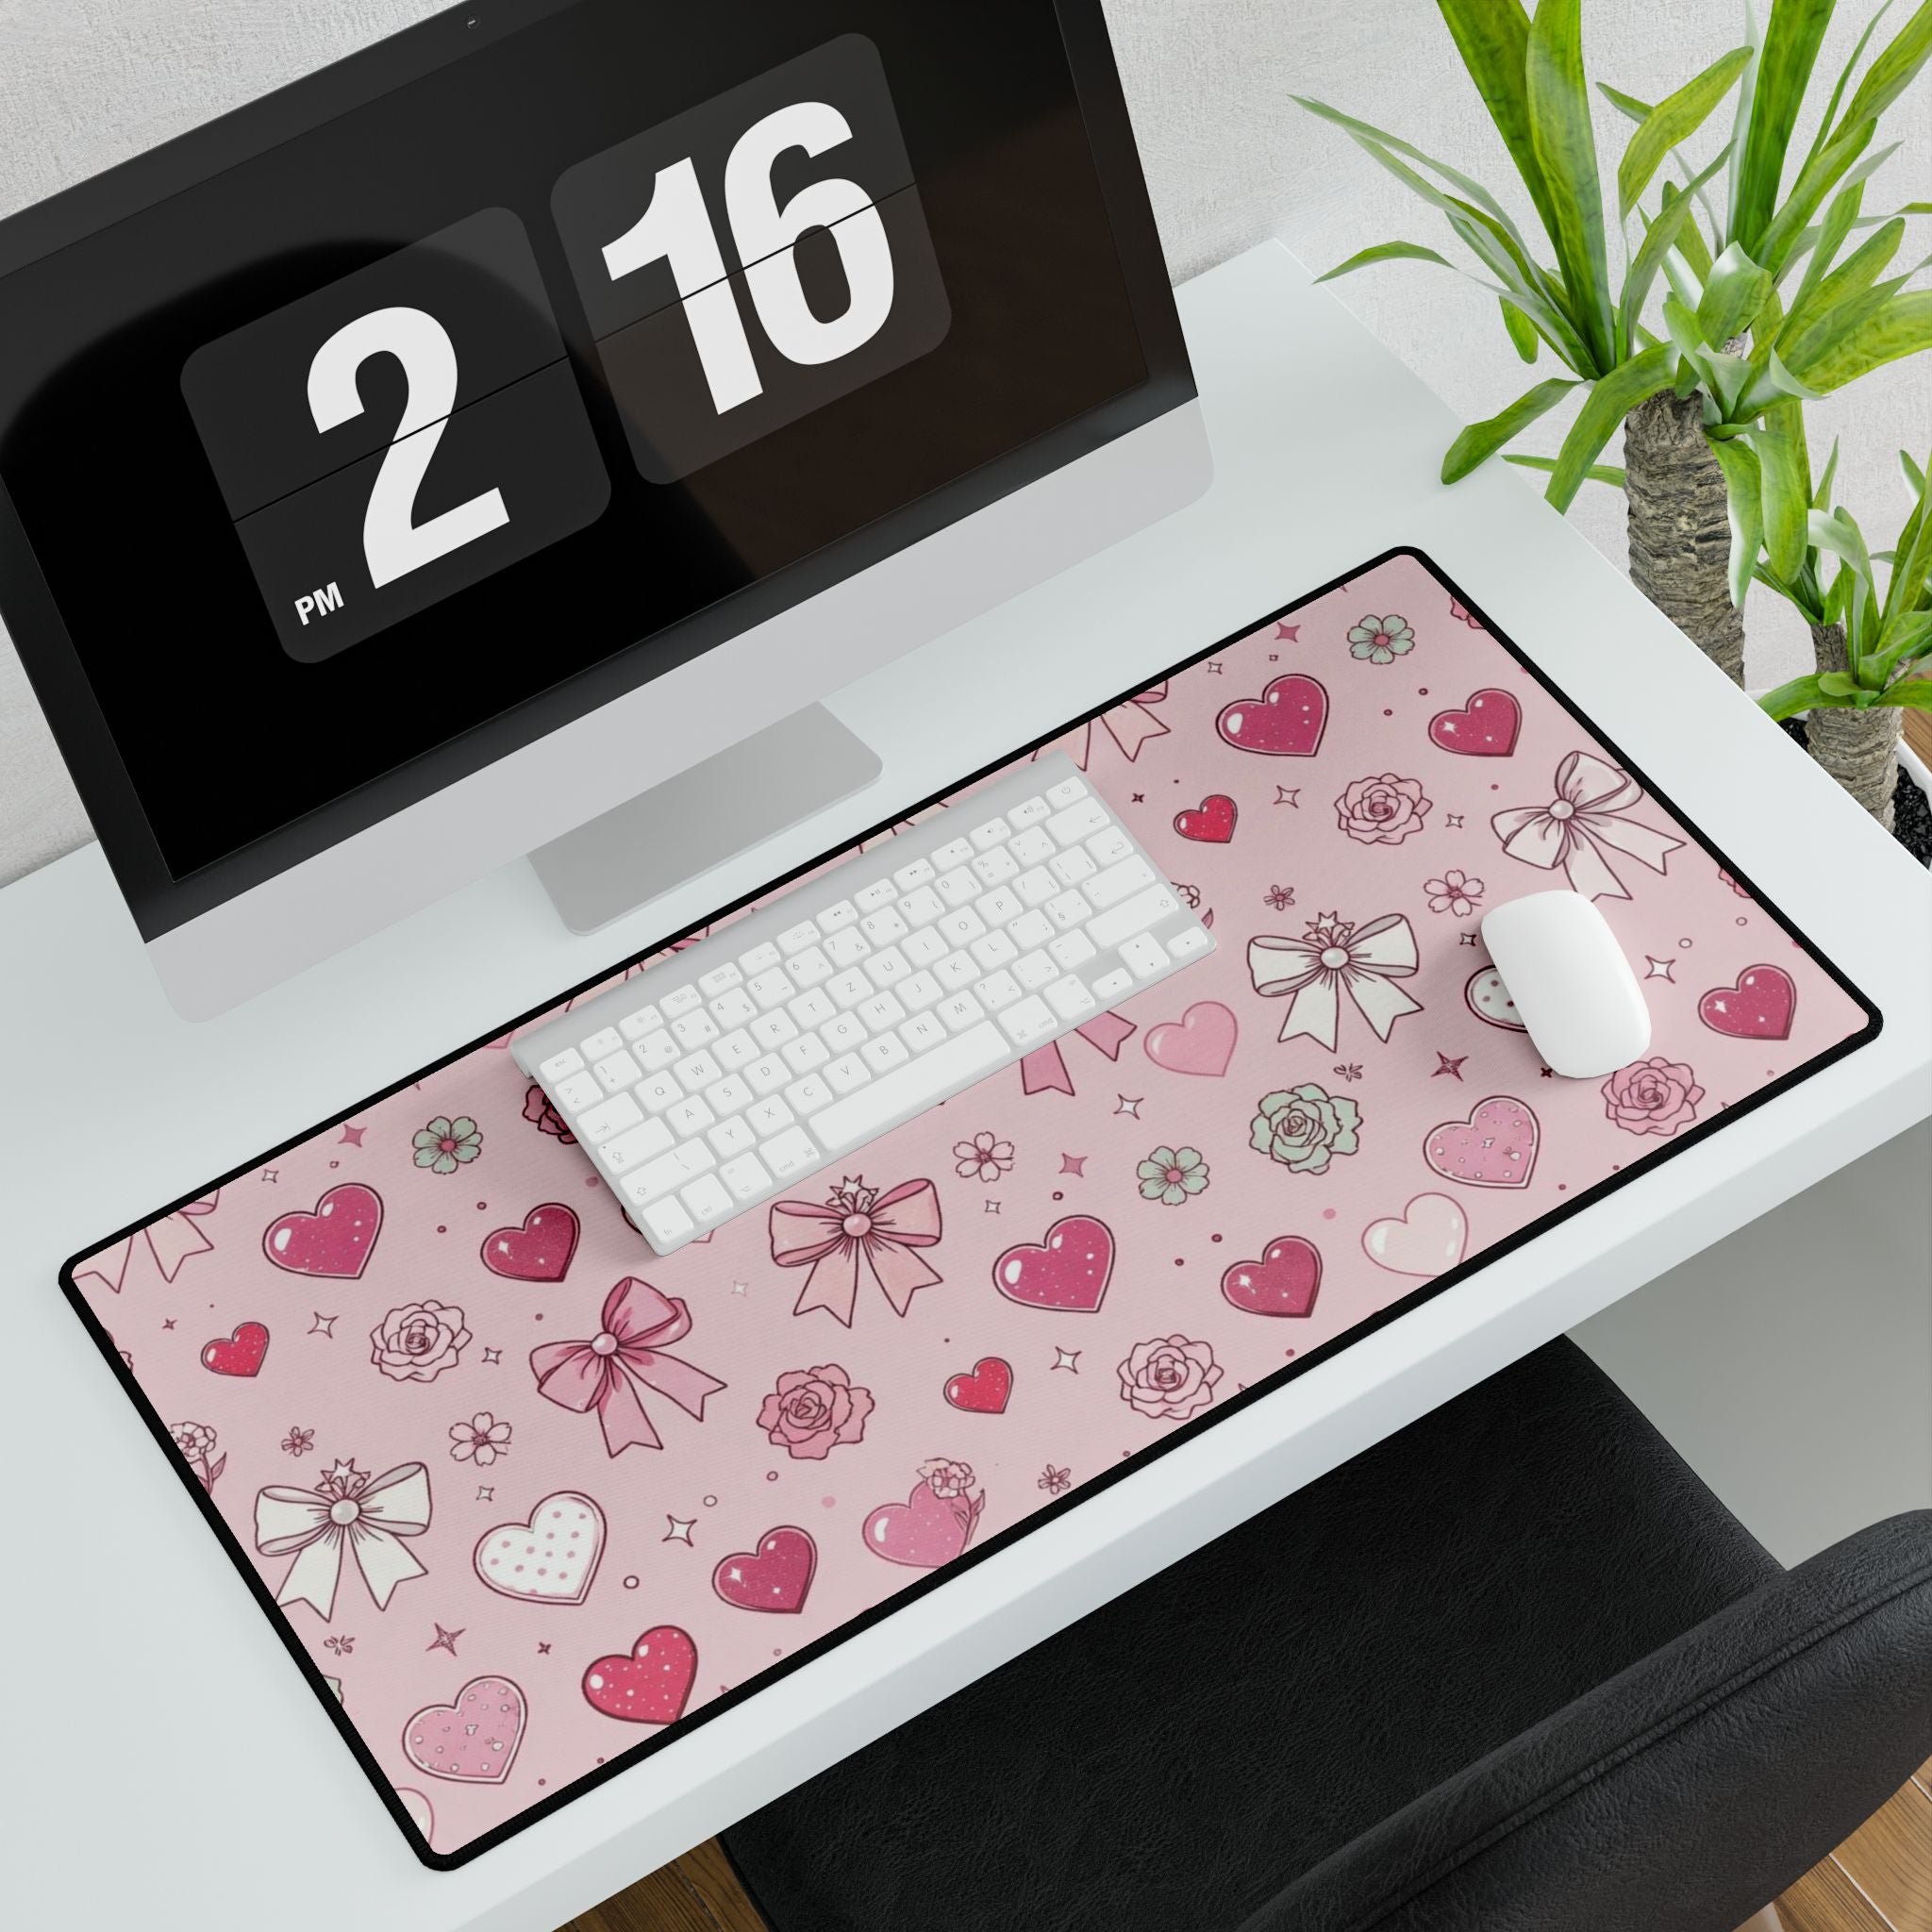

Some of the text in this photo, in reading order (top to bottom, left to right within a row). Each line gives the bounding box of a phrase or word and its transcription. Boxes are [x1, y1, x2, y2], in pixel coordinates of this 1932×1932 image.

[308, 102, 893, 590] 2 16
[294, 582, 343, 625] PM
[904, 901, 911, 909] 9
[996, 900, 1003, 910] P
[958, 922, 968, 930] O
[828, 941, 836, 950] 7
[793, 961, 800, 971] 6
[883, 961, 893, 973] U
[950, 962, 961, 973] K
[755, 982, 762, 991] 5
[846, 982, 857, 992] Z
[808, 1003, 816, 1011] T
[874, 1004, 886, 1014] H
[954, 1004, 966, 1014] M
[677, 1024, 686, 1032] 3
[1038, 1017, 1053, 1030] cmd
[770, 1024, 780, 1034] R
[838, 1024, 847, 1034] G
[916, 1024, 928, 1034] N
[639, 1044, 647, 1054] 2
[732, 1044, 741, 1056] E
[800, 1045, 807, 1055] F
[878, 1045, 890, 1055] B
[691, 1064, 704, 1075] W
[760, 1067, 770, 1077] D
[840, 1066, 849, 1075] V
[655, 1087, 666, 1095] Q
[723, 1088, 732, 1097] S
[803, 1087, 813, 1096] C
[686, 1109, 694, 1120] A
[764, 1108, 775, 1119] X
[724, 1128, 734, 1139] Y
[779, 1160, 795, 1173] cmd
